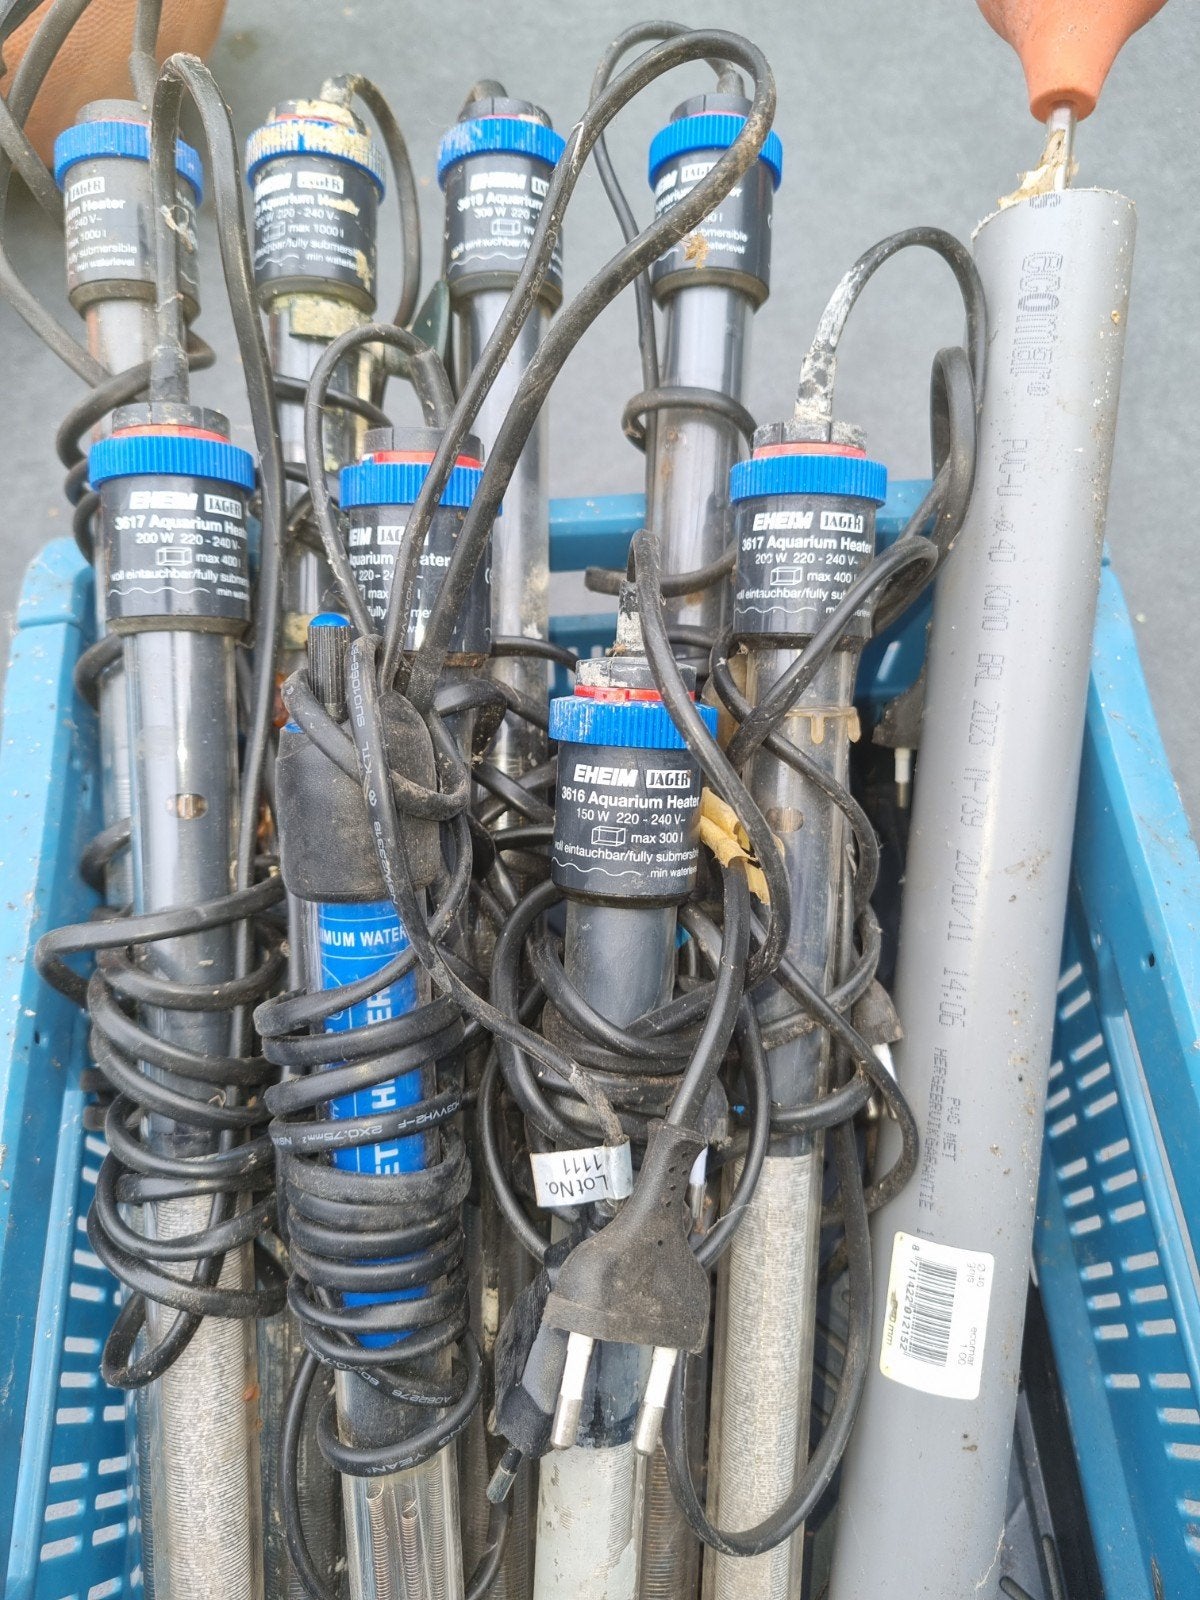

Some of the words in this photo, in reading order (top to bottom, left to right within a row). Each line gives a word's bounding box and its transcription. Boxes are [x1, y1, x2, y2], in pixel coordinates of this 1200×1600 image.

[82, 197, 126, 212] Heater
[114, 514, 146, 531] 3617
[148, 514, 223, 534] Aquarium
[135, 532, 158, 545] 200
[159, 531, 175, 544] W
[180, 532, 204, 546] 220
[211, 535, 232, 550] 240
[741, 536, 765, 552] 3617
[767, 534, 838, 551] Aquarium
[840, 536, 872, 554] Heater
[195, 553, 220, 565] max
[775, 552, 787, 564] W
[793, 552, 816, 564] 220
[825, 553, 846, 566] 240
[359, 569, 375, 582] 220
[806, 571, 831, 582] max
[833, 571, 852, 584] 400
[368, 588, 389, 600] max
[744, 587, 829, 602] eintauchbar/fully
[982, 584, 1013, 632] KOMO
[974, 653, 1005, 688] BRL
[359, 740, 374, 774] KTL
[573, 763, 639, 788] EHEIM
[561, 786, 586, 803] 3616
[588, 790, 663, 809] Aquarium
[667, 795, 700, 809] Heater
[576, 807, 595, 821] 150
[597, 811, 610, 822] W
[616, 812, 640, 825] 220
[651, 813, 672, 825] 240
[630, 833, 657, 844] max
[659, 832, 679, 844] 300
[564, 842, 653, 865] eintauchbar/fully
[650, 868, 668, 878] min
[398, 1100, 460, 1131] H03VVH2-F
[563, 1154, 602, 1175] 1111
